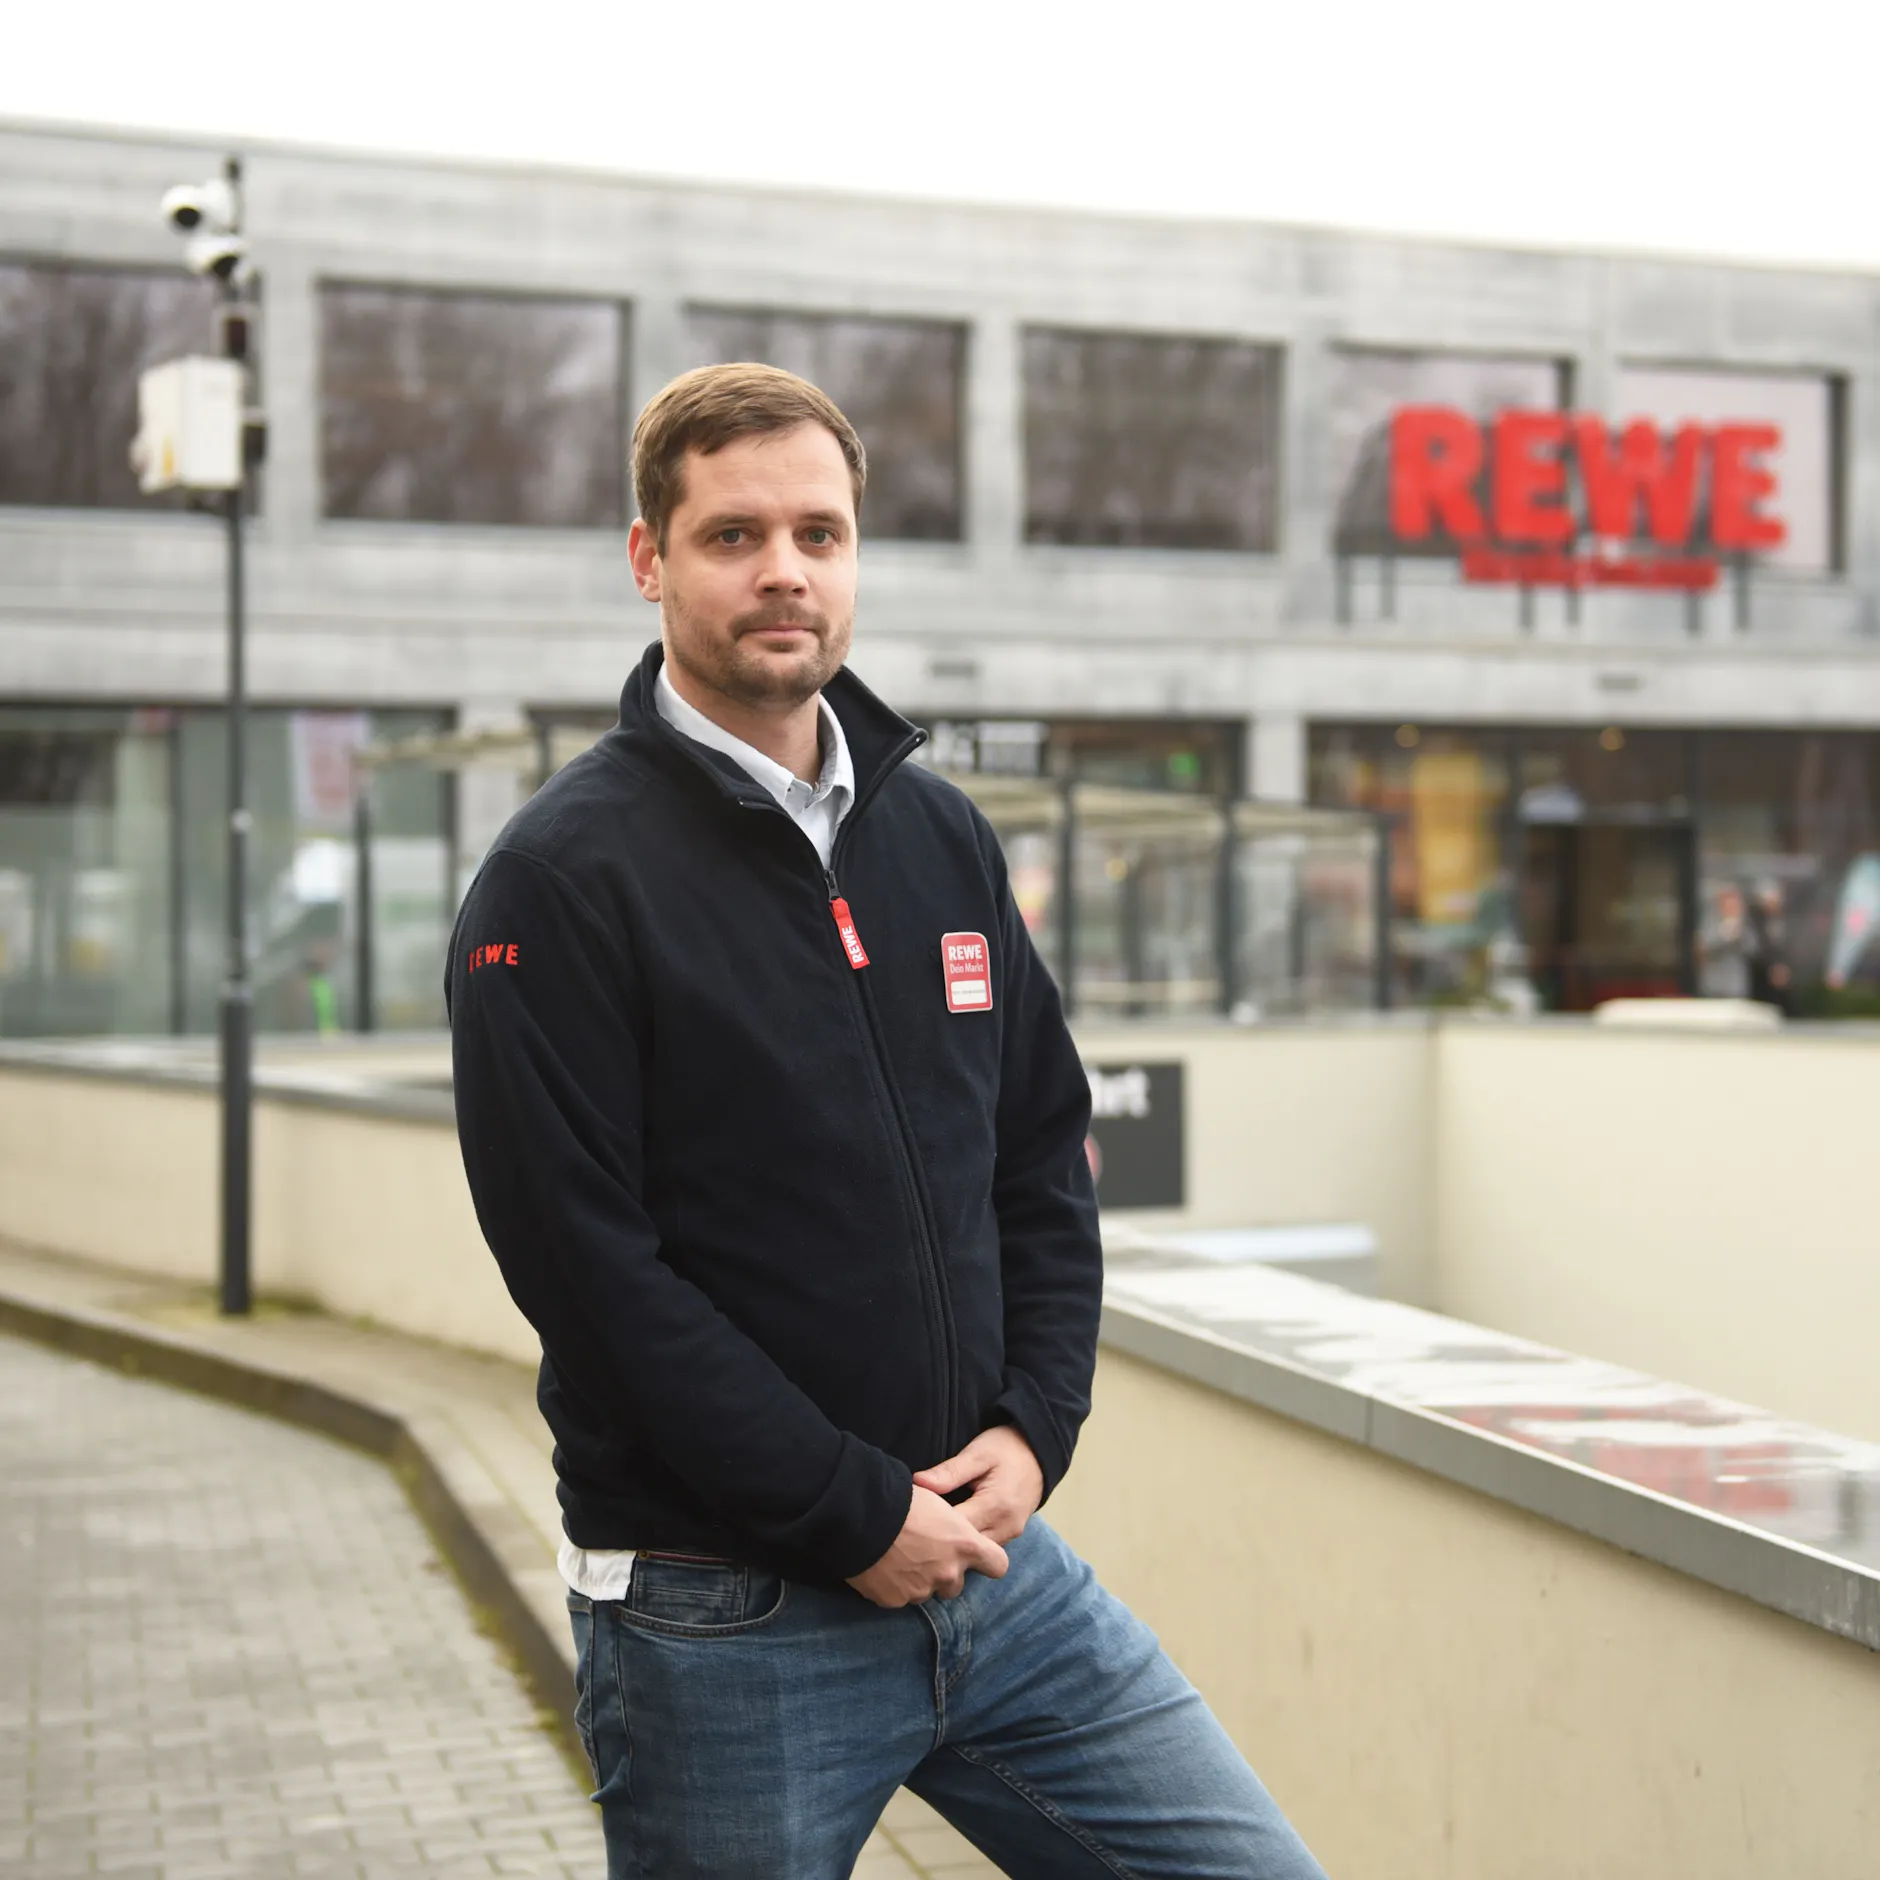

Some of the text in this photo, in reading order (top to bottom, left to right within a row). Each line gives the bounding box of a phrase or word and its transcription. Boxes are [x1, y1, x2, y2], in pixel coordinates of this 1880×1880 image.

[1389, 403, 1787, 549] REWE
[842, 925, 864, 963] REWE
[947, 944, 982, 961] REWE
[950, 962, 984, 974] Dein Markt
